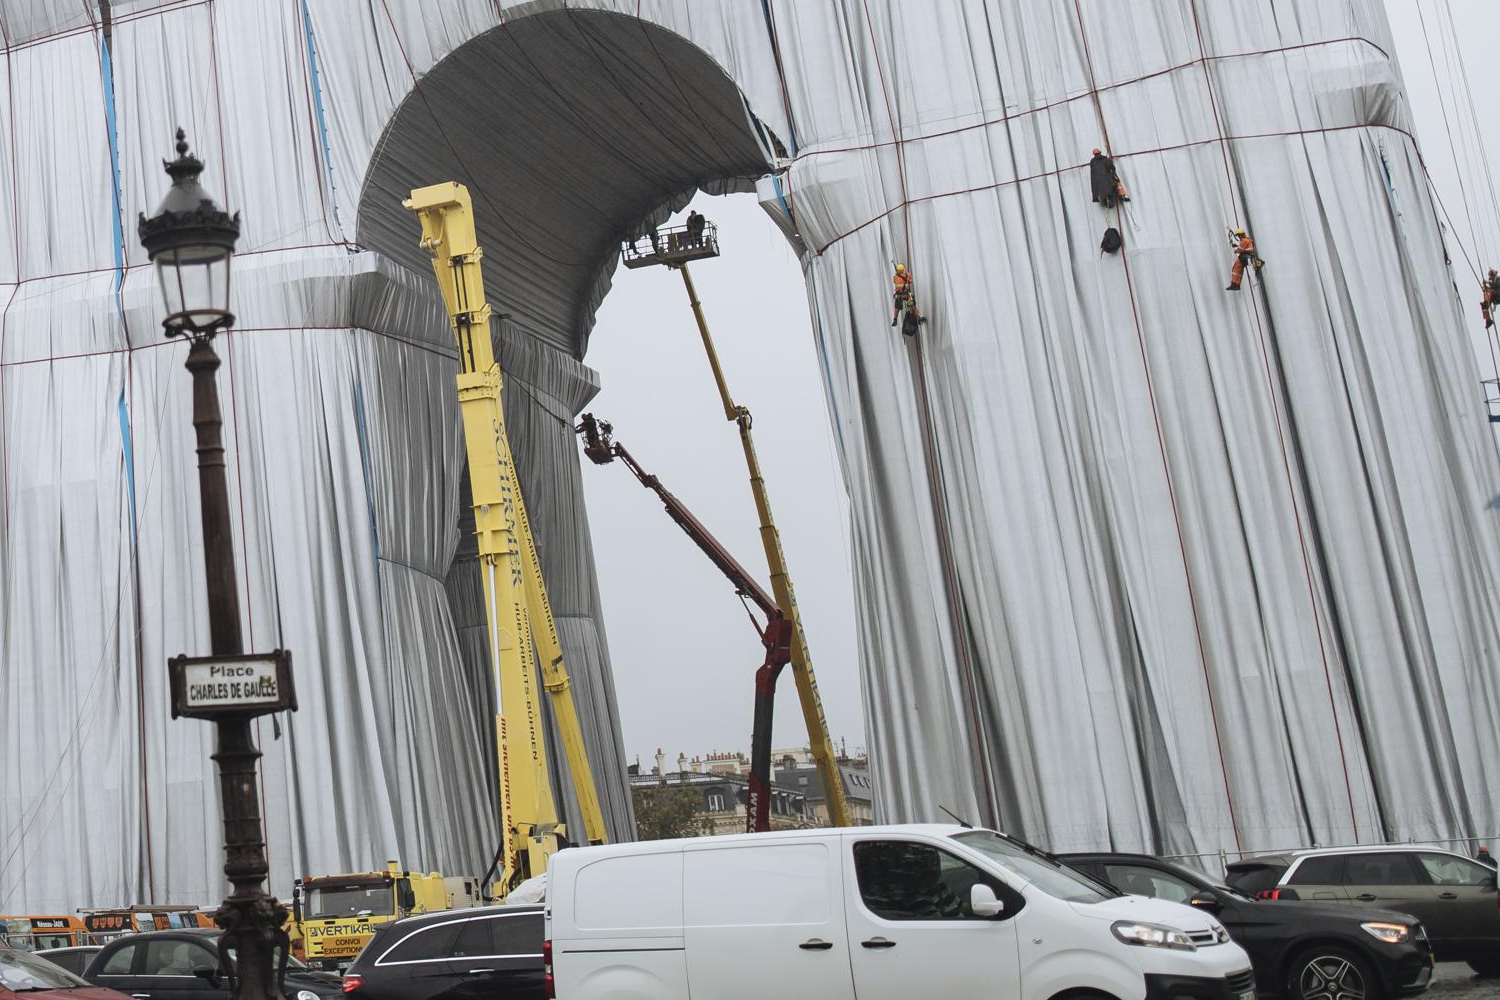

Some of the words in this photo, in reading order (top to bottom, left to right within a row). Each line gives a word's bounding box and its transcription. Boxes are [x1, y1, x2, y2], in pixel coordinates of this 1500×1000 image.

[492, 418, 523, 588] SCHIRMER
[210, 666, 254, 677] Place
[190, 683, 228, 701] CHARLES
[231, 682, 242, 699] DE
[244, 681, 277, 698] GAULLE
[336, 938, 361, 946] CONVOI
